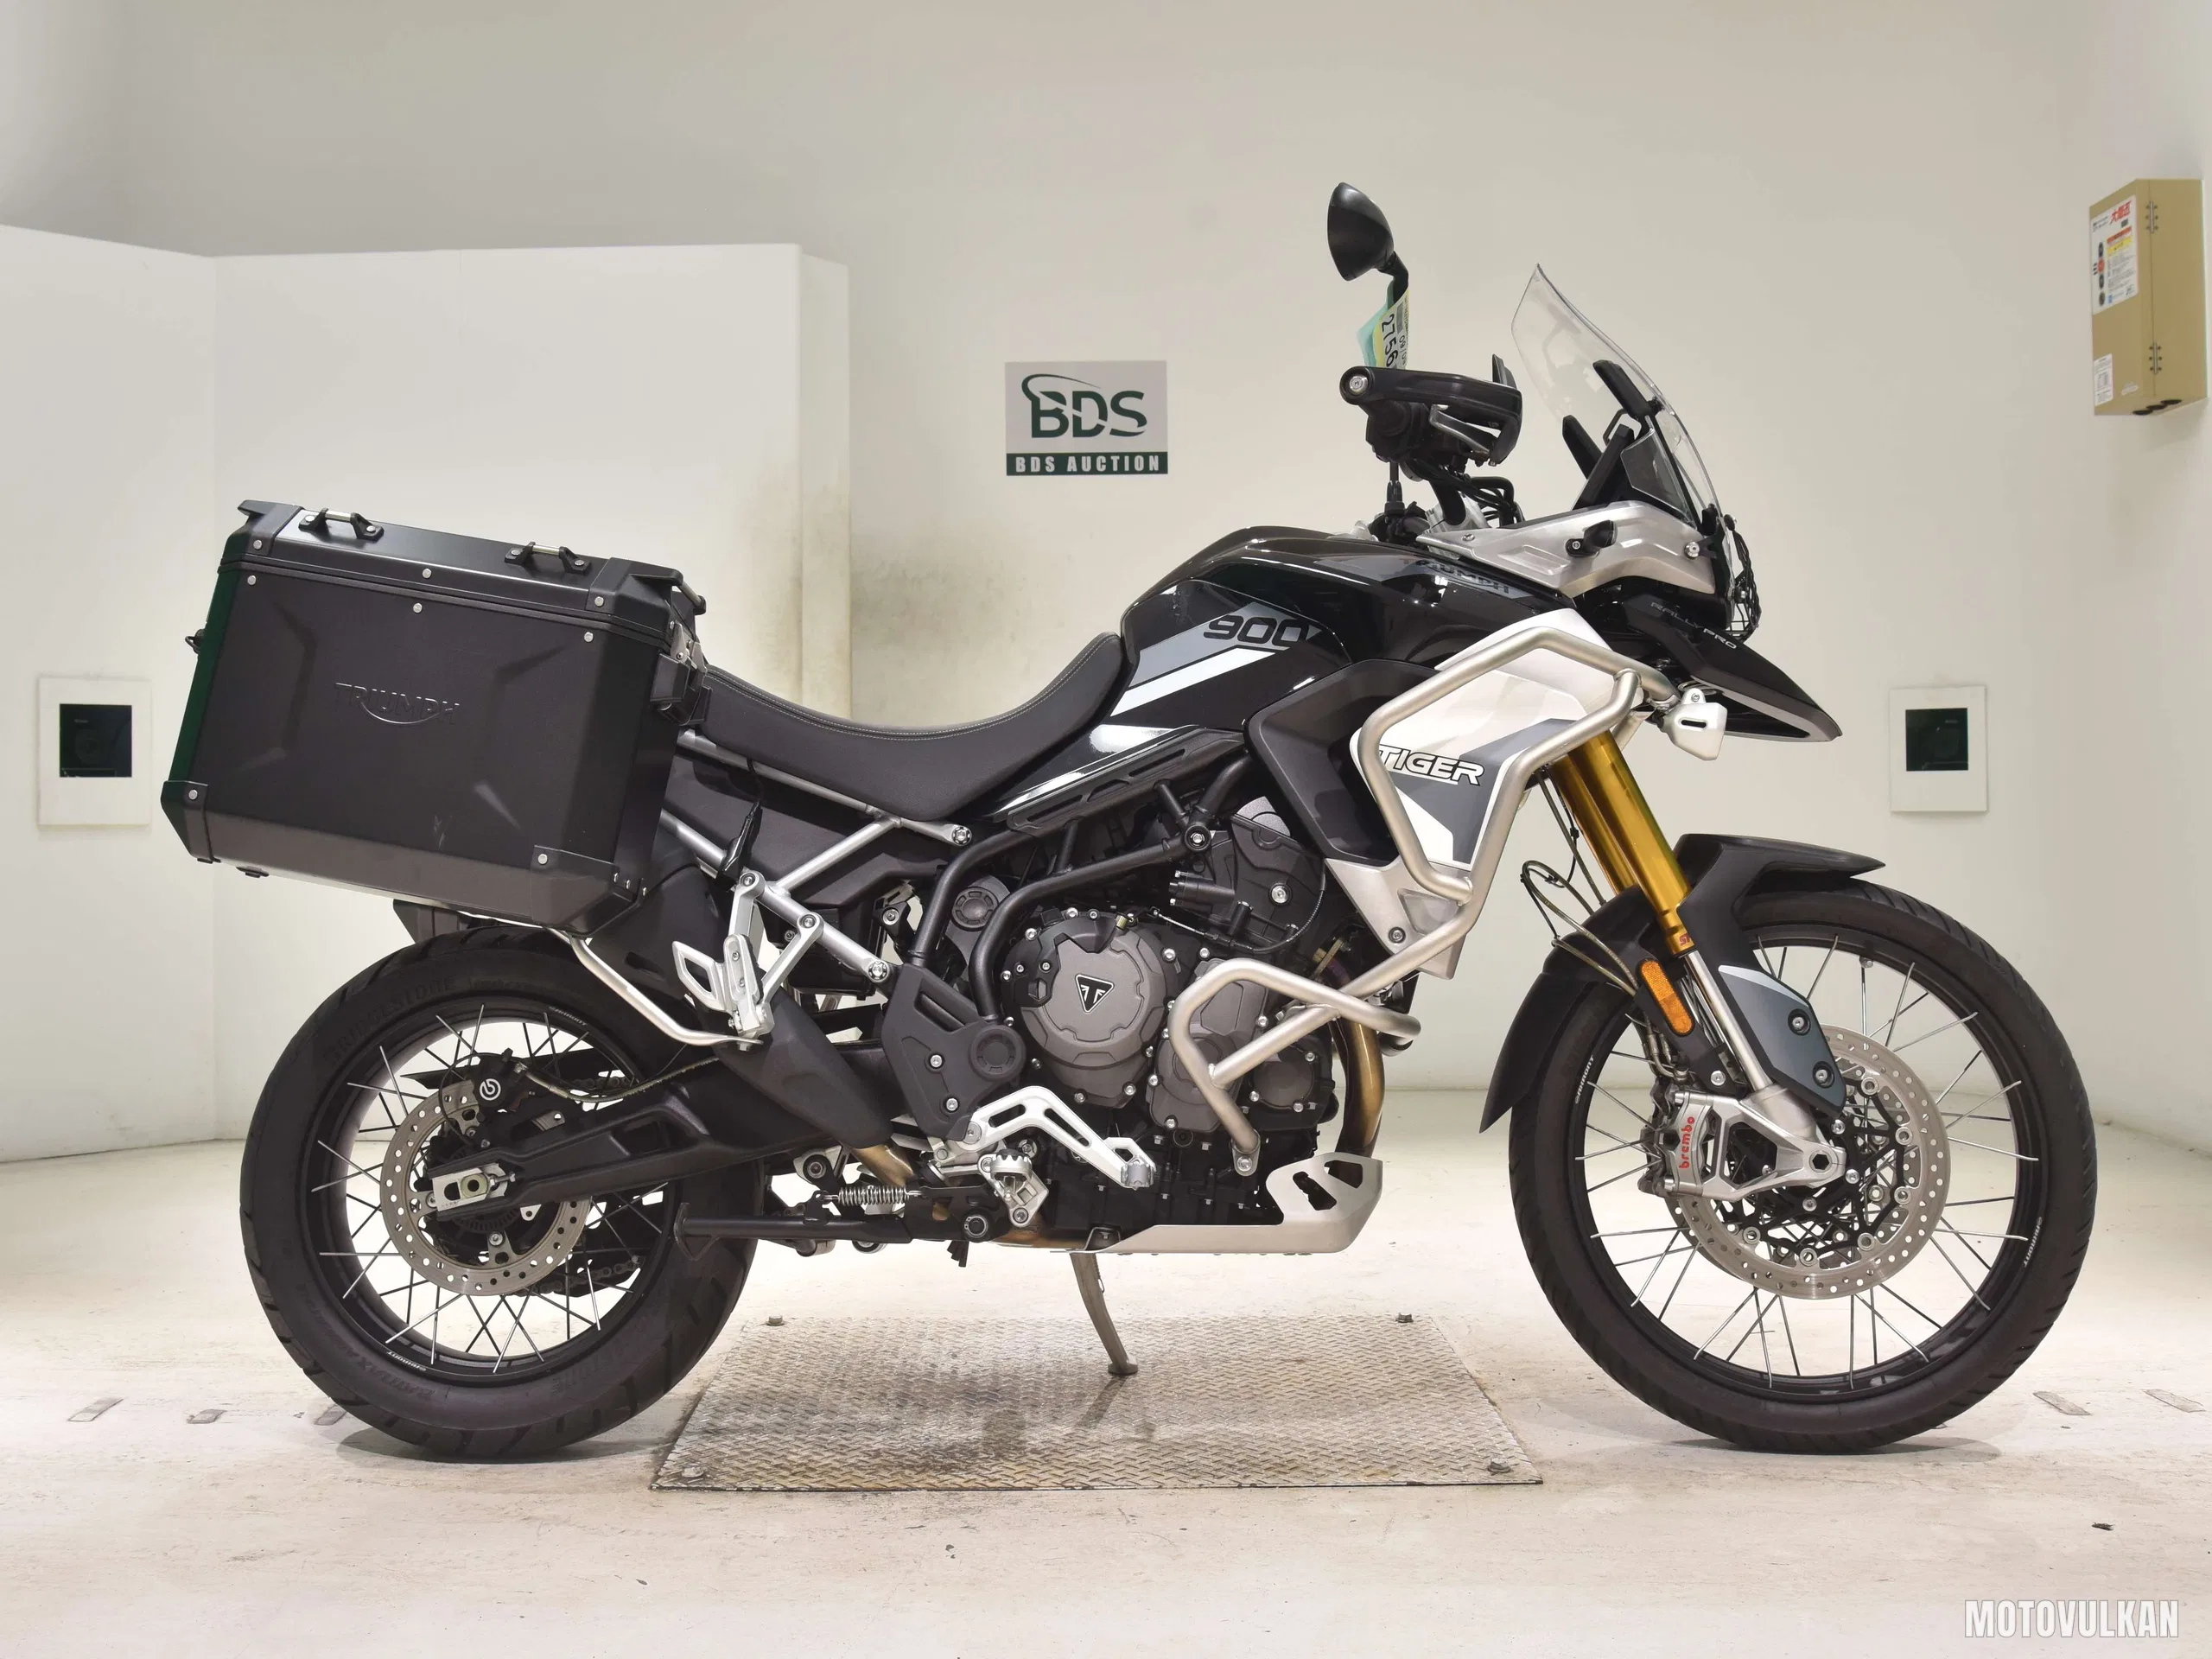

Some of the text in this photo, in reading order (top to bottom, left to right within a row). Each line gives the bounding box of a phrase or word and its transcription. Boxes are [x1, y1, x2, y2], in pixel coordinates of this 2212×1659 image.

[1381, 313, 1398, 367] 2756
[1021, 374, 1147, 439] BDS
[1015, 454, 1160, 473] BDS AUCTION
[1203, 613, 1310, 647] 900
[1702, 627, 1737, 649] PRO
[335, 682, 461, 726] TRIUMPH
[1379, 743, 1485, 786] TIGER
[1679, 1116, 1695, 1169] brembo
